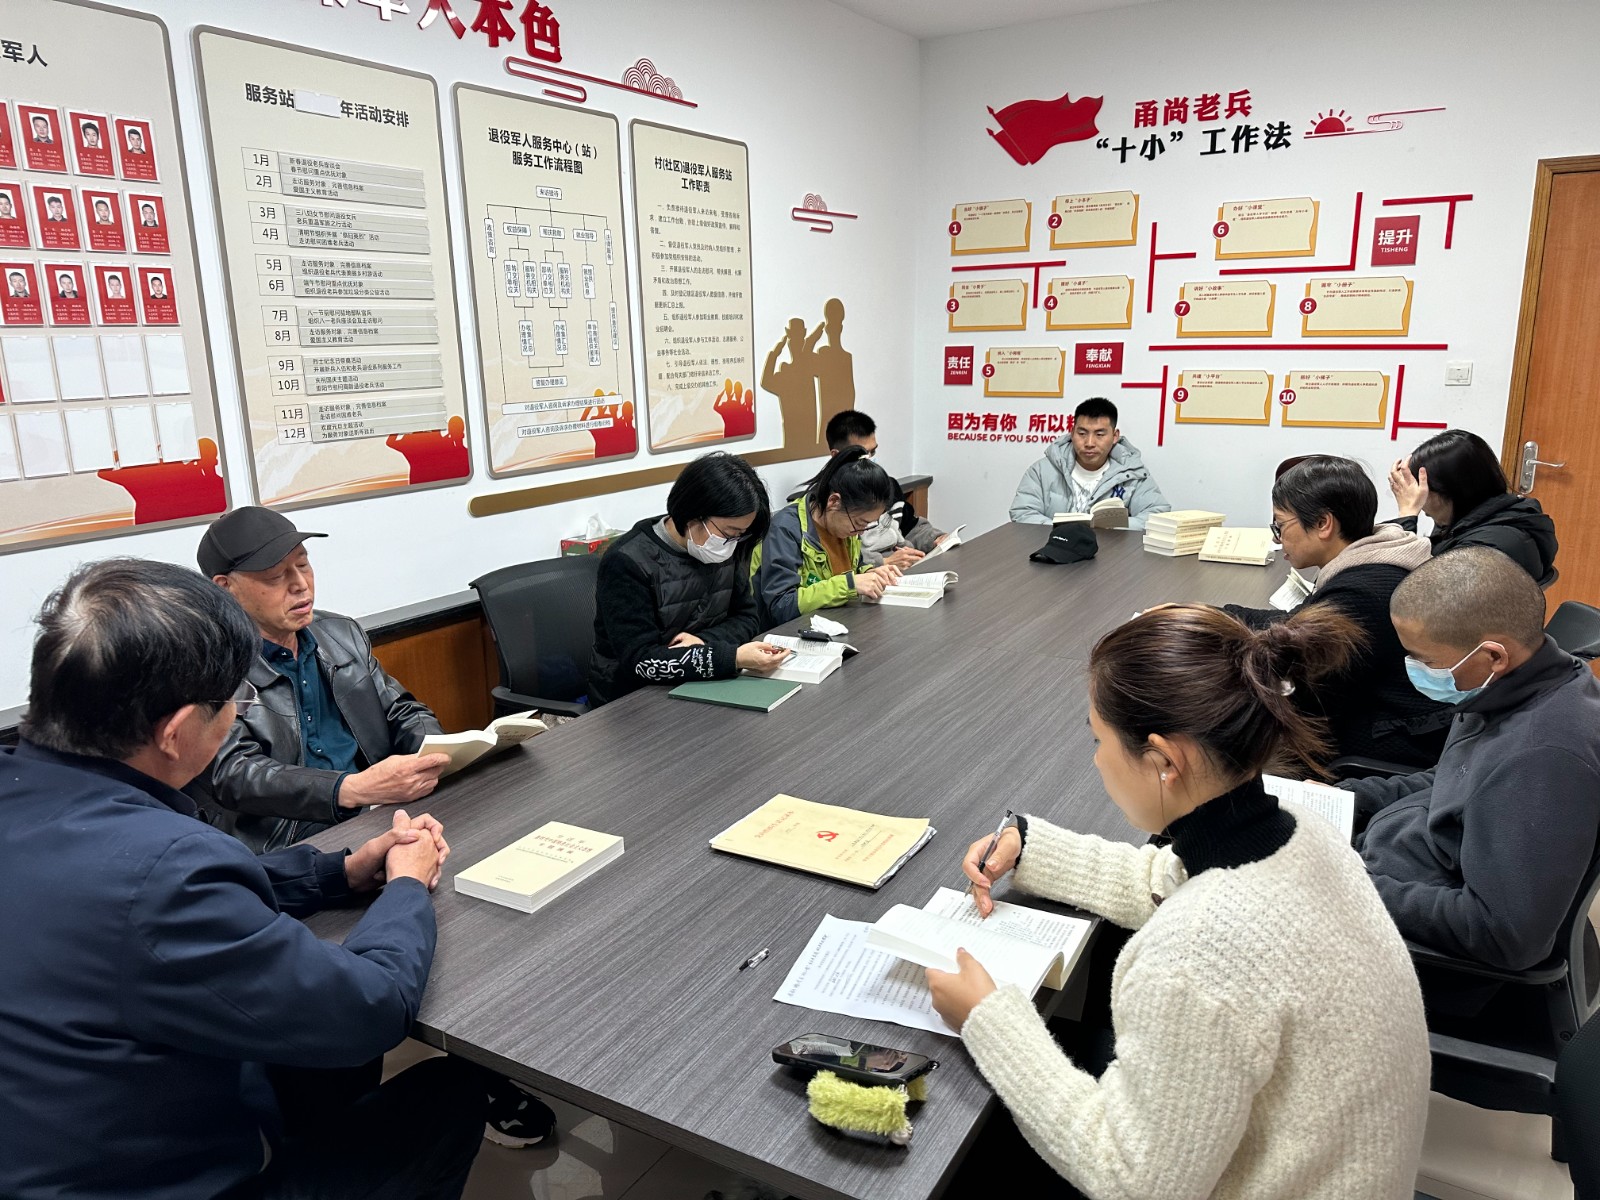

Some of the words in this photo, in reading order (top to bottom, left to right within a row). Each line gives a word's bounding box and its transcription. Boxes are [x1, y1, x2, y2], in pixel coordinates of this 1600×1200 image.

[0, 39, 48, 67] 军人
[245, 83, 295, 108] 服务站
[340, 100, 410, 128] 年活动安排
[1134, 89, 1252, 129] 甬尚老兵
[488, 127, 598, 159] 退役军人服务中心（站）
[253, 154, 269, 166] 1月
[512, 151, 583, 175] 服务工作流程图
[256, 175, 272, 188] 2月
[681, 177, 710, 193] 工作职责
[259, 207, 276, 219] 3月
[1051, 216, 1059, 227] 2
[262, 228, 279, 240] 4月
[952, 224, 959, 234] 1
[1217, 225, 1225, 235] 6
[1378, 228, 1413, 246] 提升
[266, 259, 282, 271] 5月
[269, 280, 285, 292] 6月
[950, 301, 956, 310] 3
[1048, 299, 1054, 307] 4
[1179, 304, 1186, 313] 7
[1304, 301, 1312, 311] 8
[272, 310, 288, 322] 7月
[275, 330, 291, 342] 8月
[1085, 348, 1112, 362] 奉献
[278, 360, 294, 371] 9月
[947, 356, 971, 370] 责任
[986, 366, 992, 375] 5
[278, 379, 300, 391] 10月
[1177, 390, 1184, 400] 9
[1281, 392, 1294, 402] 10
[281, 408, 303, 420] 11月
[947, 412, 1017, 432] 因为有你
[284, 428, 306, 439] 12月
[947, 432, 988, 442] BECAUSE
[990, 433, 1003, 442] OF
[1004, 434, 1023, 443] YOU
[1026, 435, 1039, 443] SO
